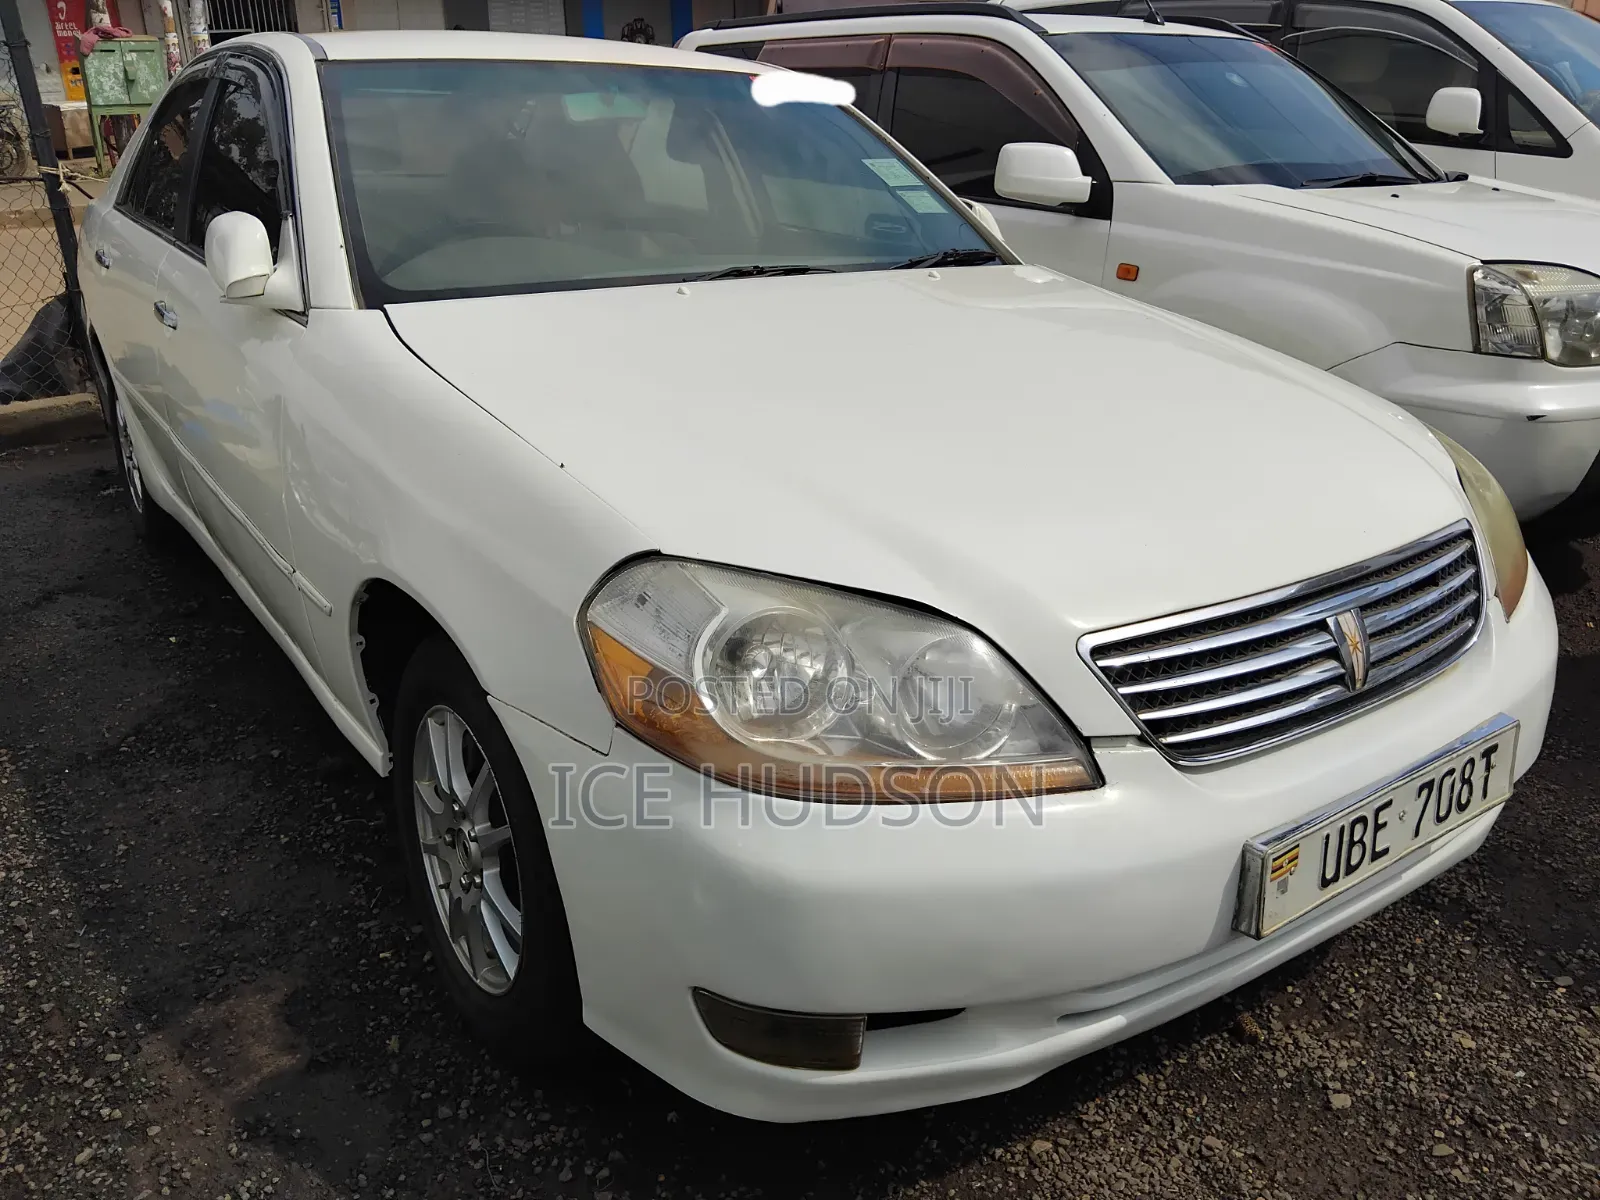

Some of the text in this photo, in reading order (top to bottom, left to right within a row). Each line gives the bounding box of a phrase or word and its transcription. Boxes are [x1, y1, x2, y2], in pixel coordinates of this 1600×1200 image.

[55, 22, 77, 30] airtel
[70, 79, 83, 87] MT
[1319, 743, 1499, 889] UBE 708T
